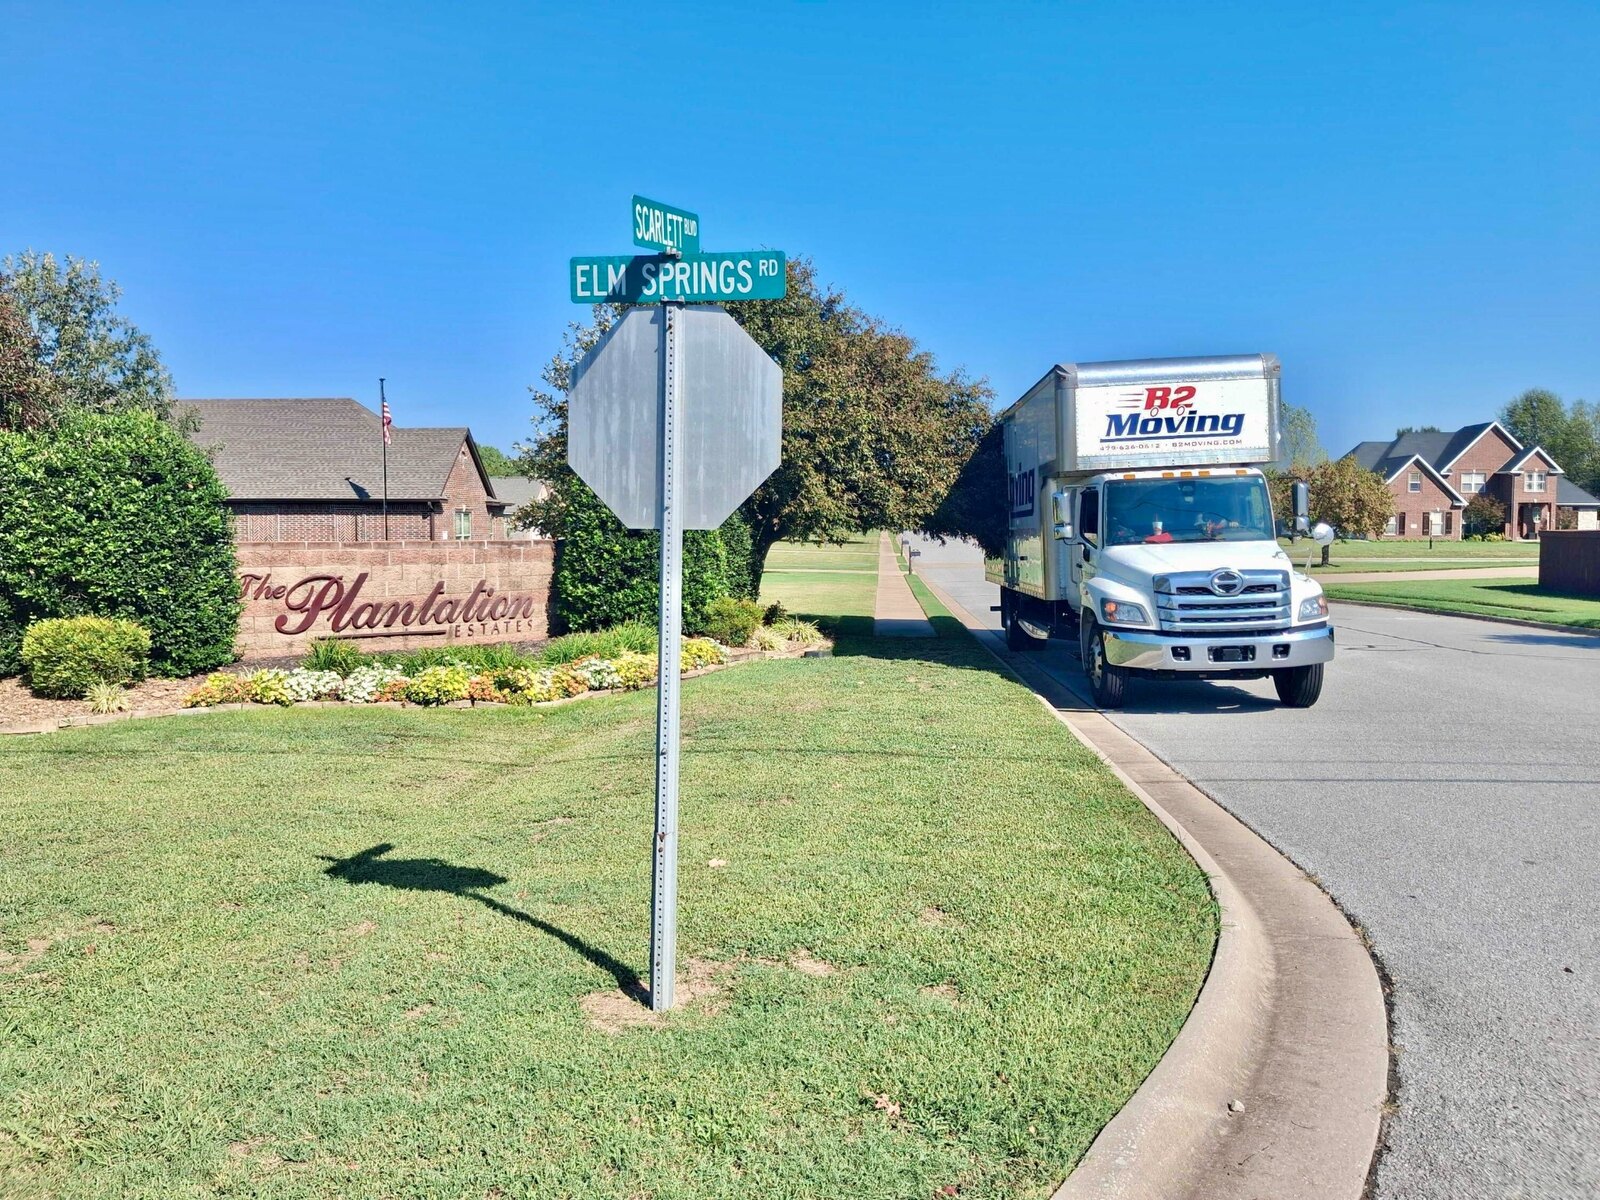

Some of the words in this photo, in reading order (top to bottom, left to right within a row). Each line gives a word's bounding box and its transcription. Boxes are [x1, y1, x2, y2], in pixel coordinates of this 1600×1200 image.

[635, 203, 683, 249] SCARLETT
[684, 217, 698, 237] BLVD
[576, 264, 627, 297] ELM
[641, 260, 753, 296] SPRINGS
[758, 259, 778, 277] RD
[1144, 385, 1197, 411] B2
[1103, 409, 1246, 440] Moving
[1171, 439, 1243, 448] B2MOVING.COM
[235, 573, 287, 600] The
[274, 572, 535, 636] Plantation
[455, 619, 534, 639] ESTATES
